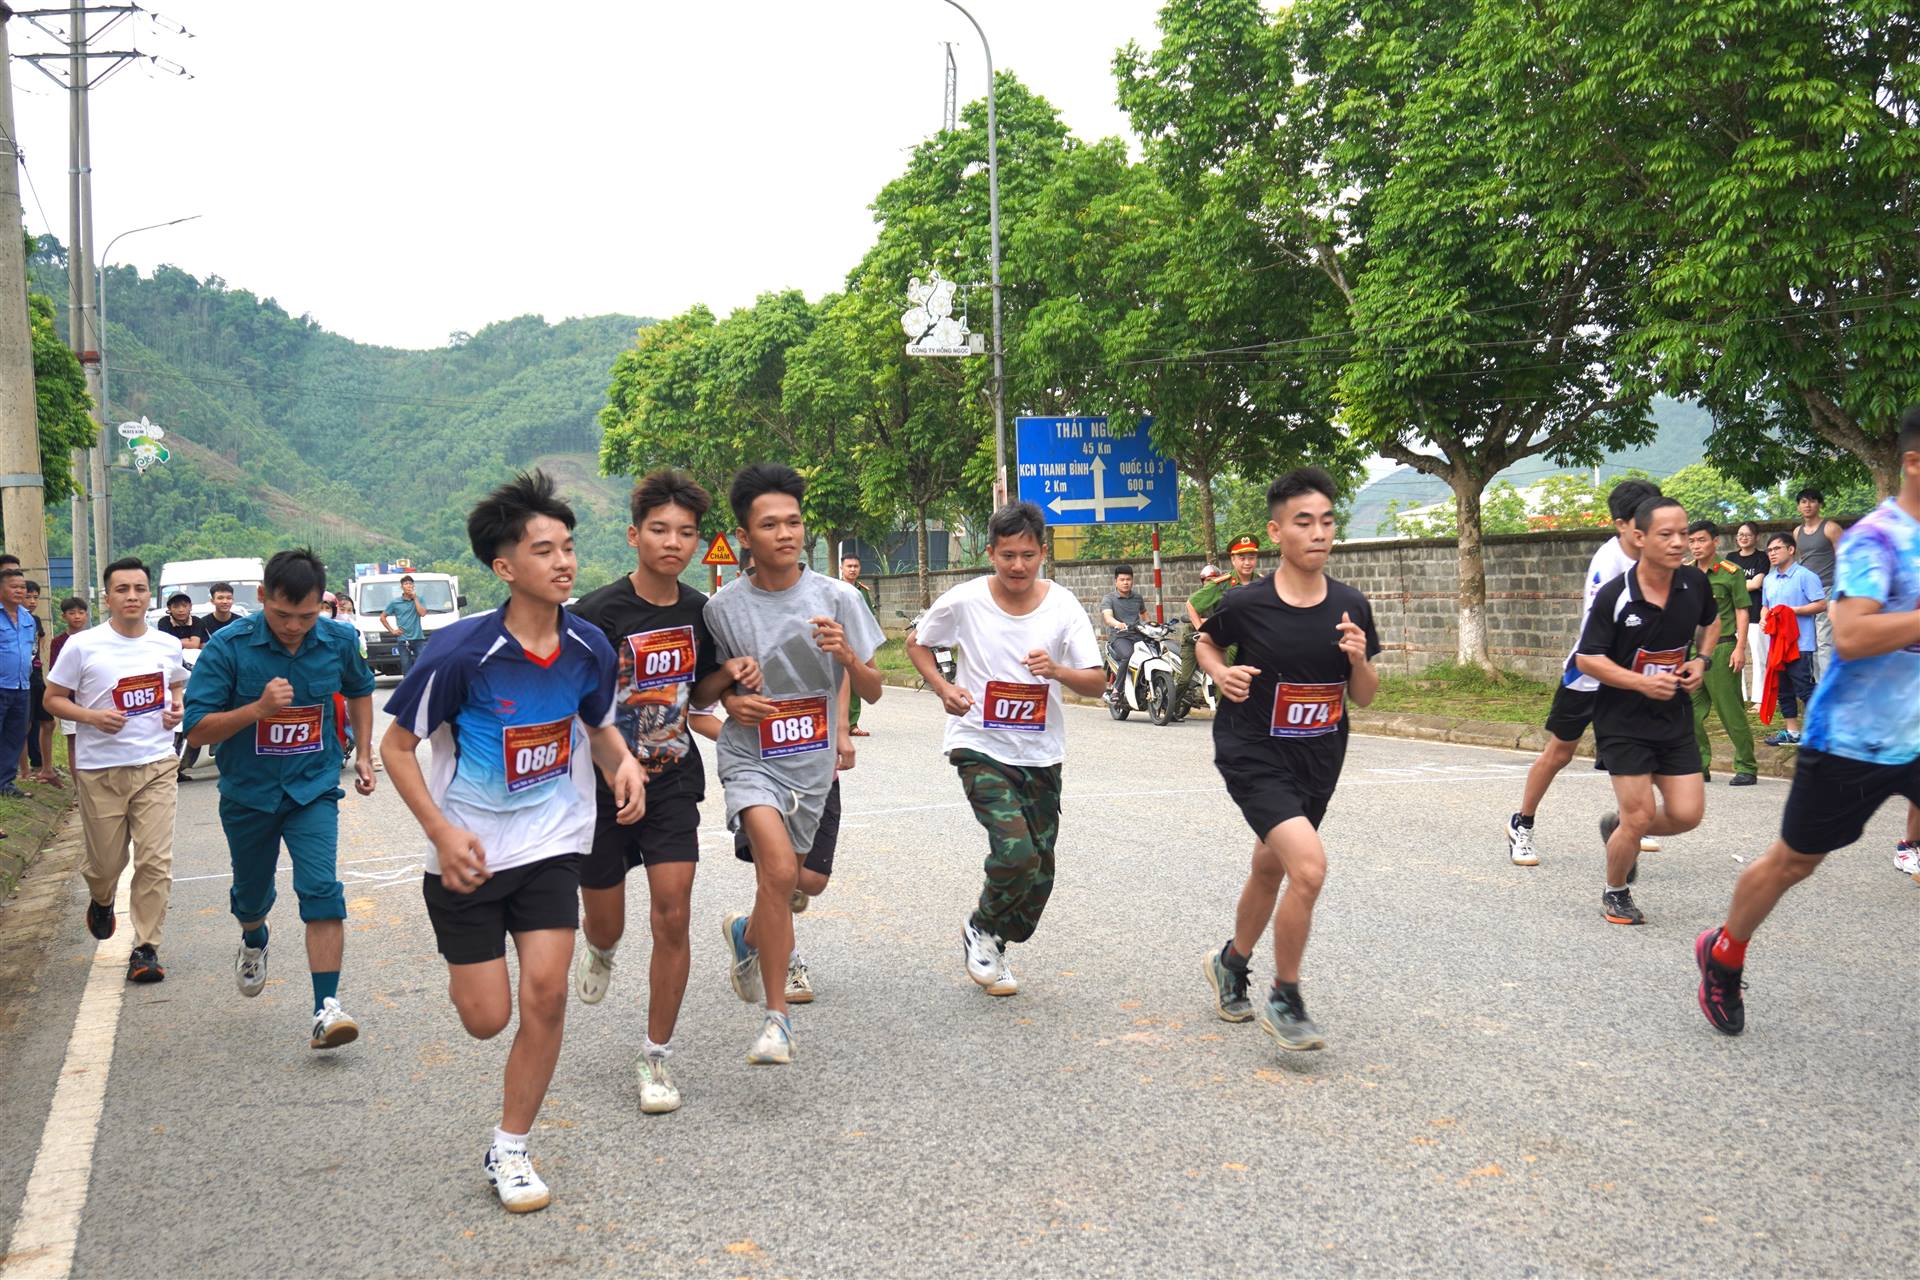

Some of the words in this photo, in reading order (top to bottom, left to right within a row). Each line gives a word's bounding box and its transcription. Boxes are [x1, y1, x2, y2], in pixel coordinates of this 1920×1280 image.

[1056, 418, 1083, 438] THÁI
[1082, 442, 1095, 454] 45
[1097, 442, 1112, 454] Km
[1020, 463, 1037, 476] KCN
[1039, 463, 1067, 476] THANH
[1069, 459, 1089, 475] BÌNH
[1120, 457, 1142, 475] QUỐC
[1145, 459, 1155, 477] LỘ
[1158, 461, 1164, 474] 3
[1044, 480, 1051, 493] 2
[1053, 480, 1068, 492] Km
[1127, 478, 1144, 491] 600
[1146, 480, 1154, 490] m
[645, 649, 681, 676] 081
[122, 687, 155, 708] 085
[994, 699, 1035, 720] 072
[1287, 703, 1329, 725] 074
[269, 723, 310, 744] 073
[771, 715, 814, 743] 088
[515, 741, 559, 775] 086
